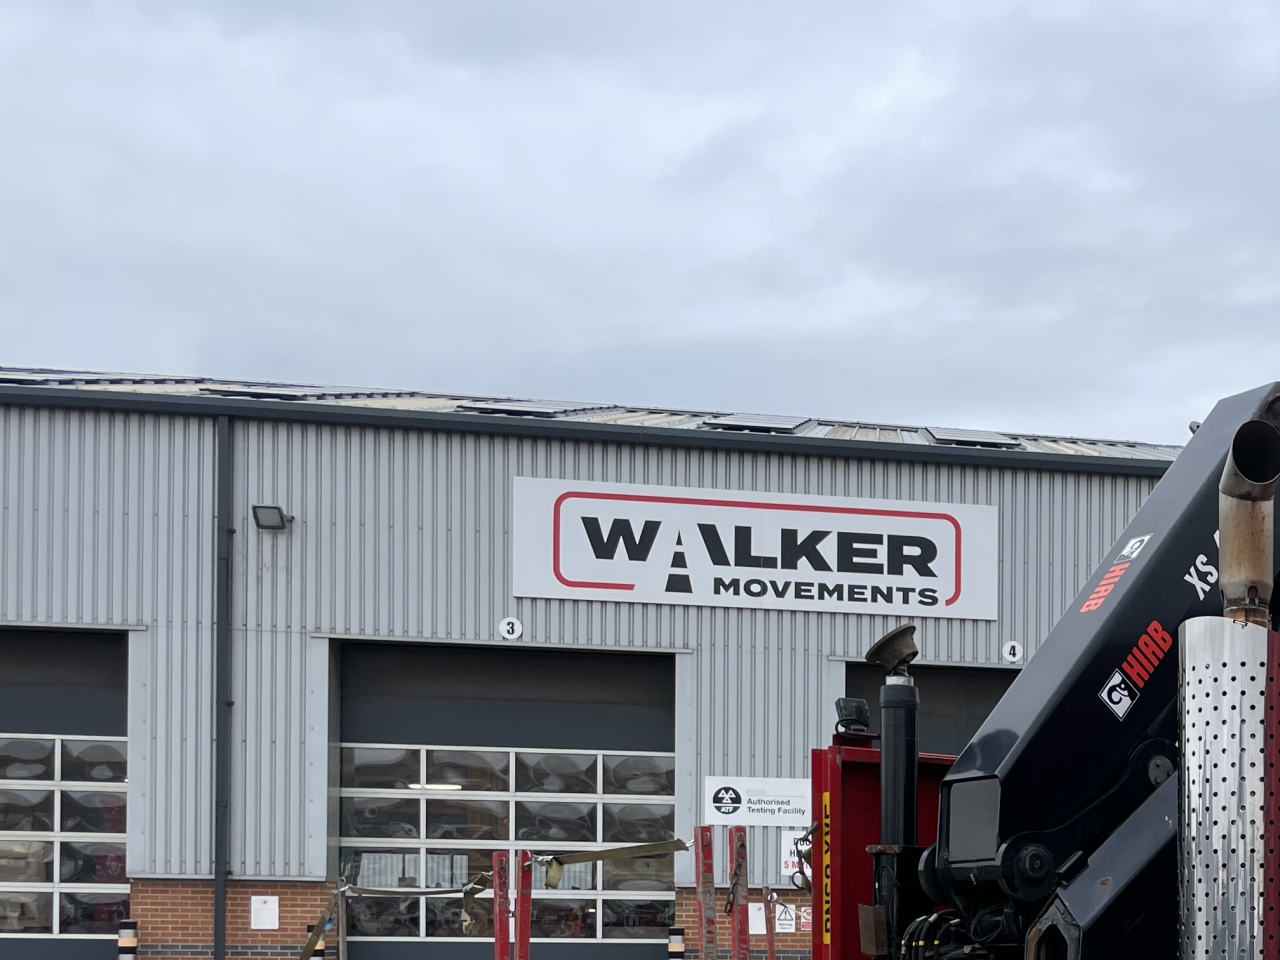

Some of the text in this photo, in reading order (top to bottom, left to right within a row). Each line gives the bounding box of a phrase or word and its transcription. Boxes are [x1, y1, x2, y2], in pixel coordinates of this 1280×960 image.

[580, 516, 939, 593] WALKER
[1183, 553, 1219, 602] XS
[713, 577, 939, 606] MOVEMENTS
[1080, 562, 1131, 613] HIAB
[506, 621, 515, 635] 3
[1009, 645, 1017, 658] 4
[1121, 620, 1173, 689] HIAB
[746, 798, 791, 806] Authorised
[720, 805, 735, 814] ATF
[746, 806, 806, 816] Testing Facility
[784, 860, 790, 870] 5
